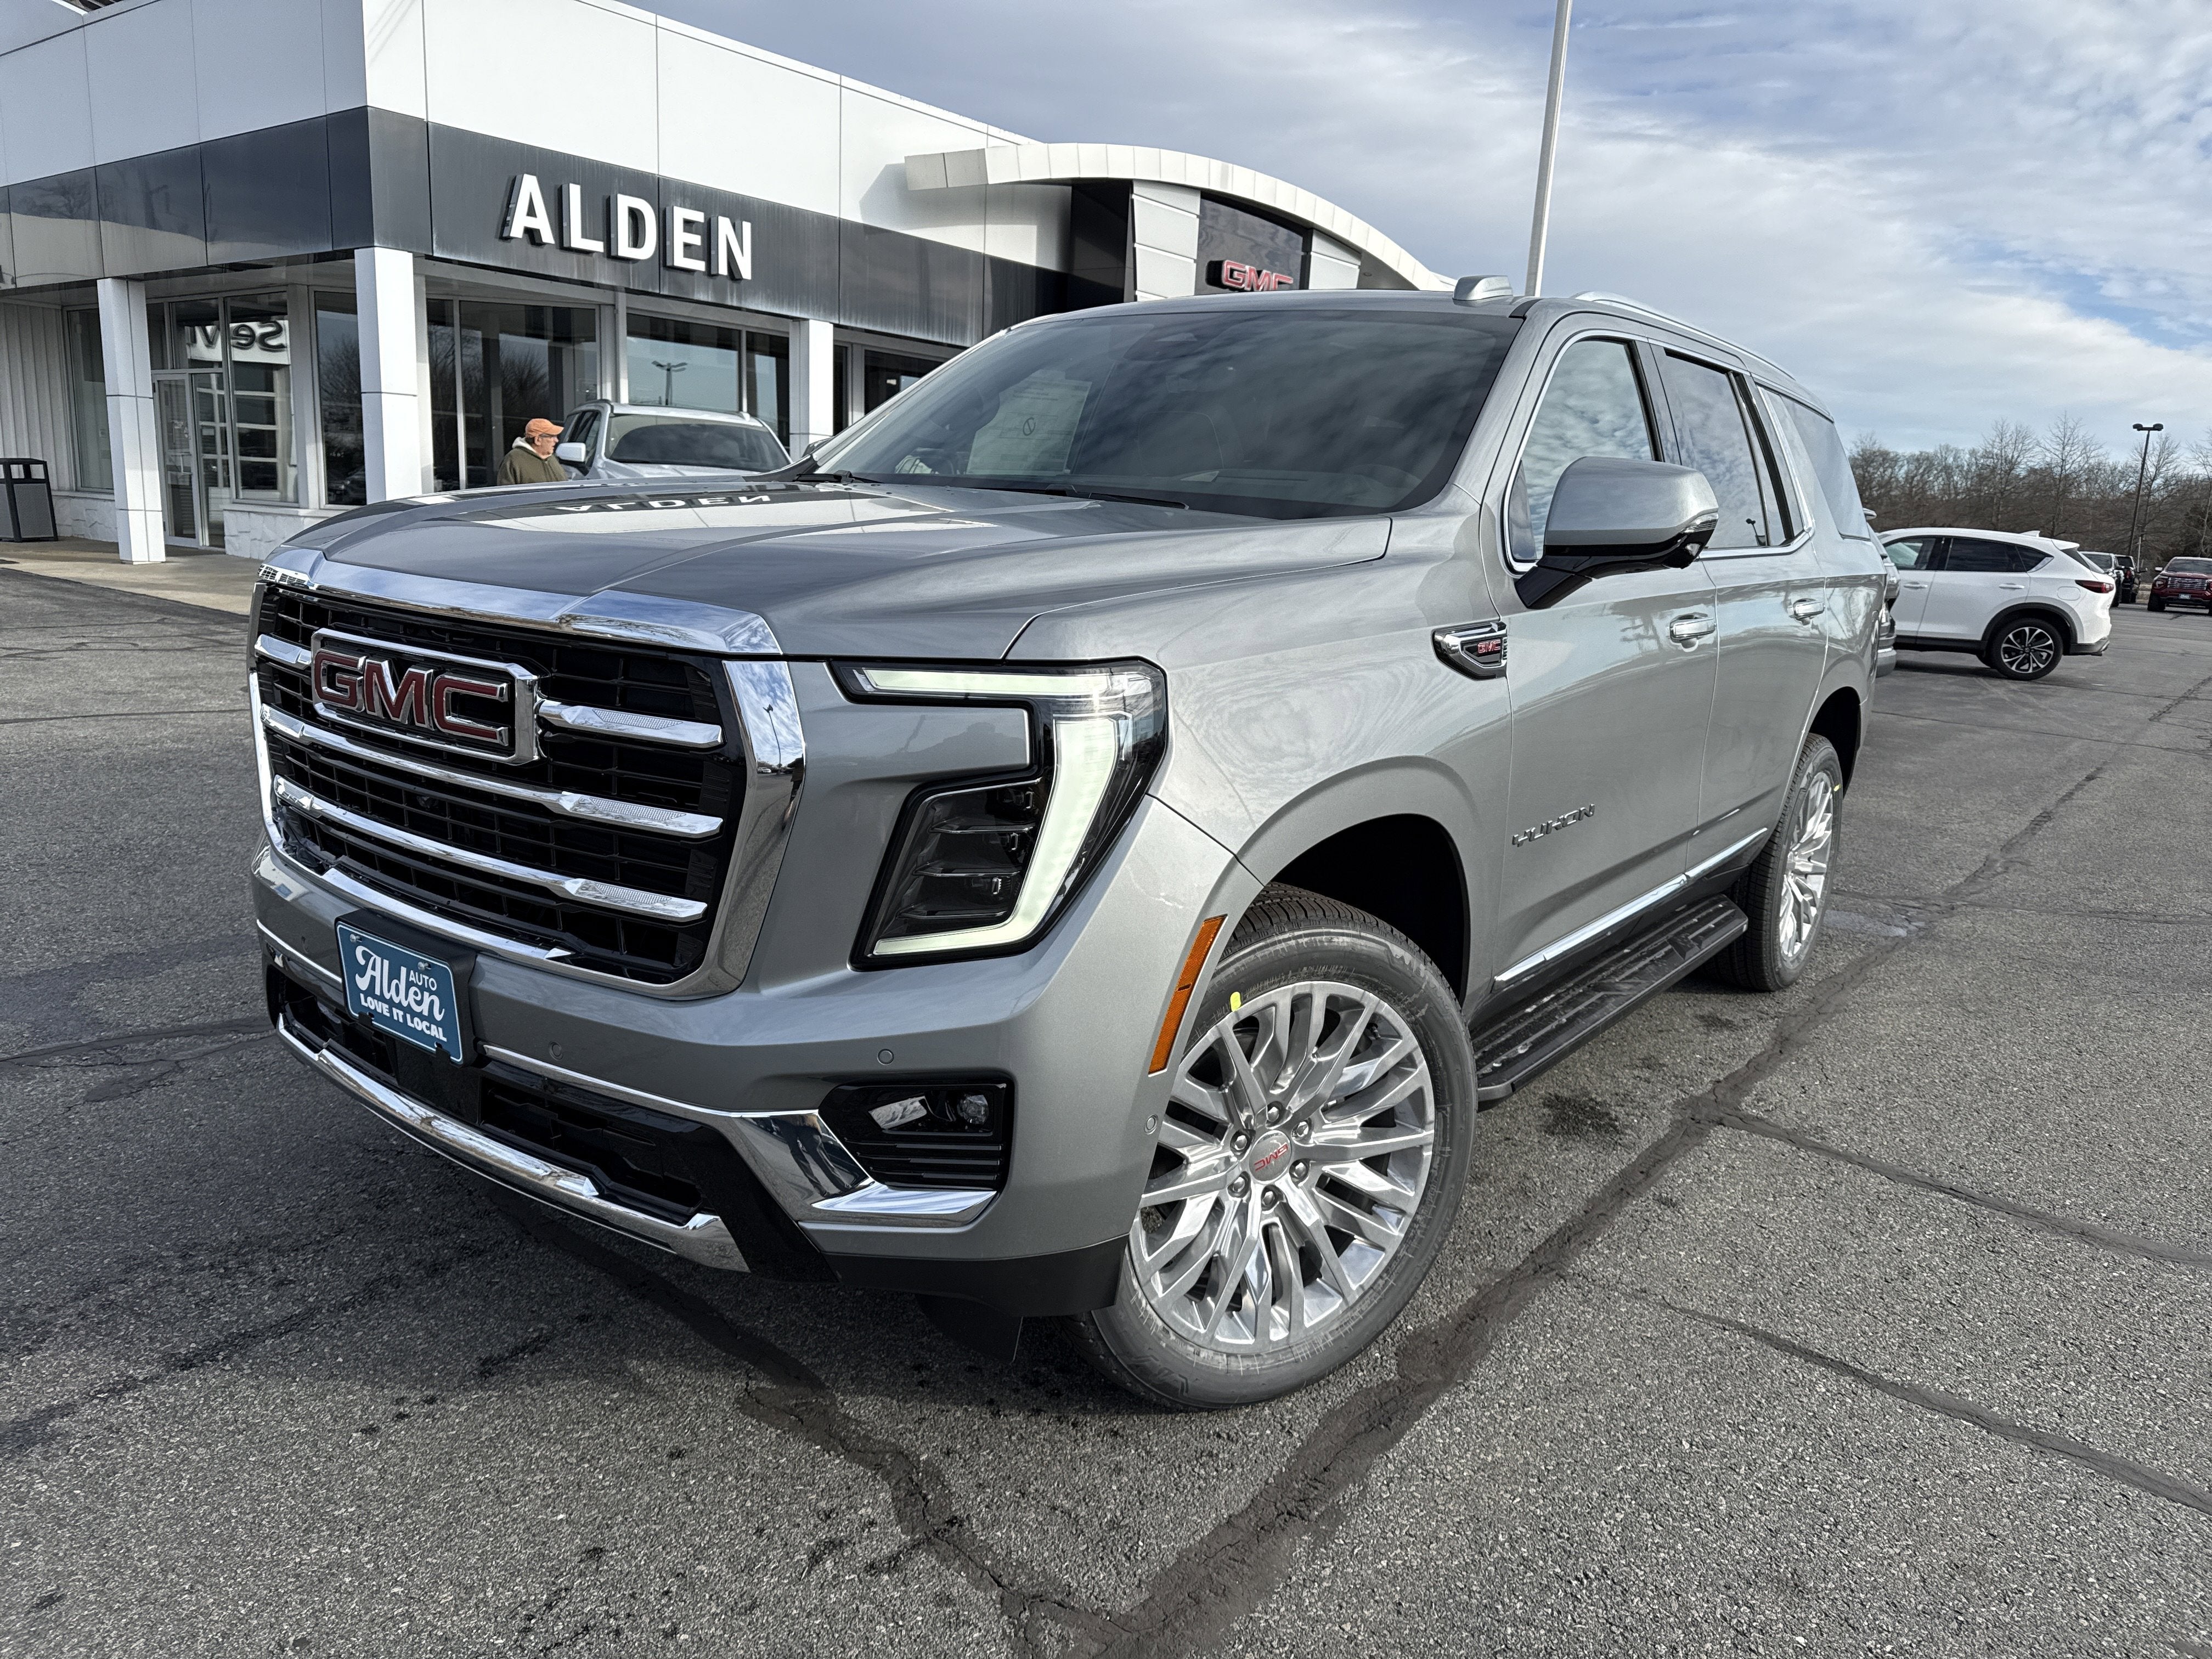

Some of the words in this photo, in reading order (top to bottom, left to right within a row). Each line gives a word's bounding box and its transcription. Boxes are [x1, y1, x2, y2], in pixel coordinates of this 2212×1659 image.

[505, 173, 752, 280] ALDEN
[1221, 259, 1294, 291] GMC
[1477, 639, 1501, 653] GMC
[314, 647, 510, 746] GMC
[1512, 803, 1595, 848] YUKON
[355, 945, 445, 1022] Alden
[409, 970, 437, 991] AUTO
[360, 993, 390, 1017] LOVE
[392, 1007, 403, 1023] IT
[406, 1013, 447, 1042] LOCAL
[1253, 1142, 1289, 1172] GMC
